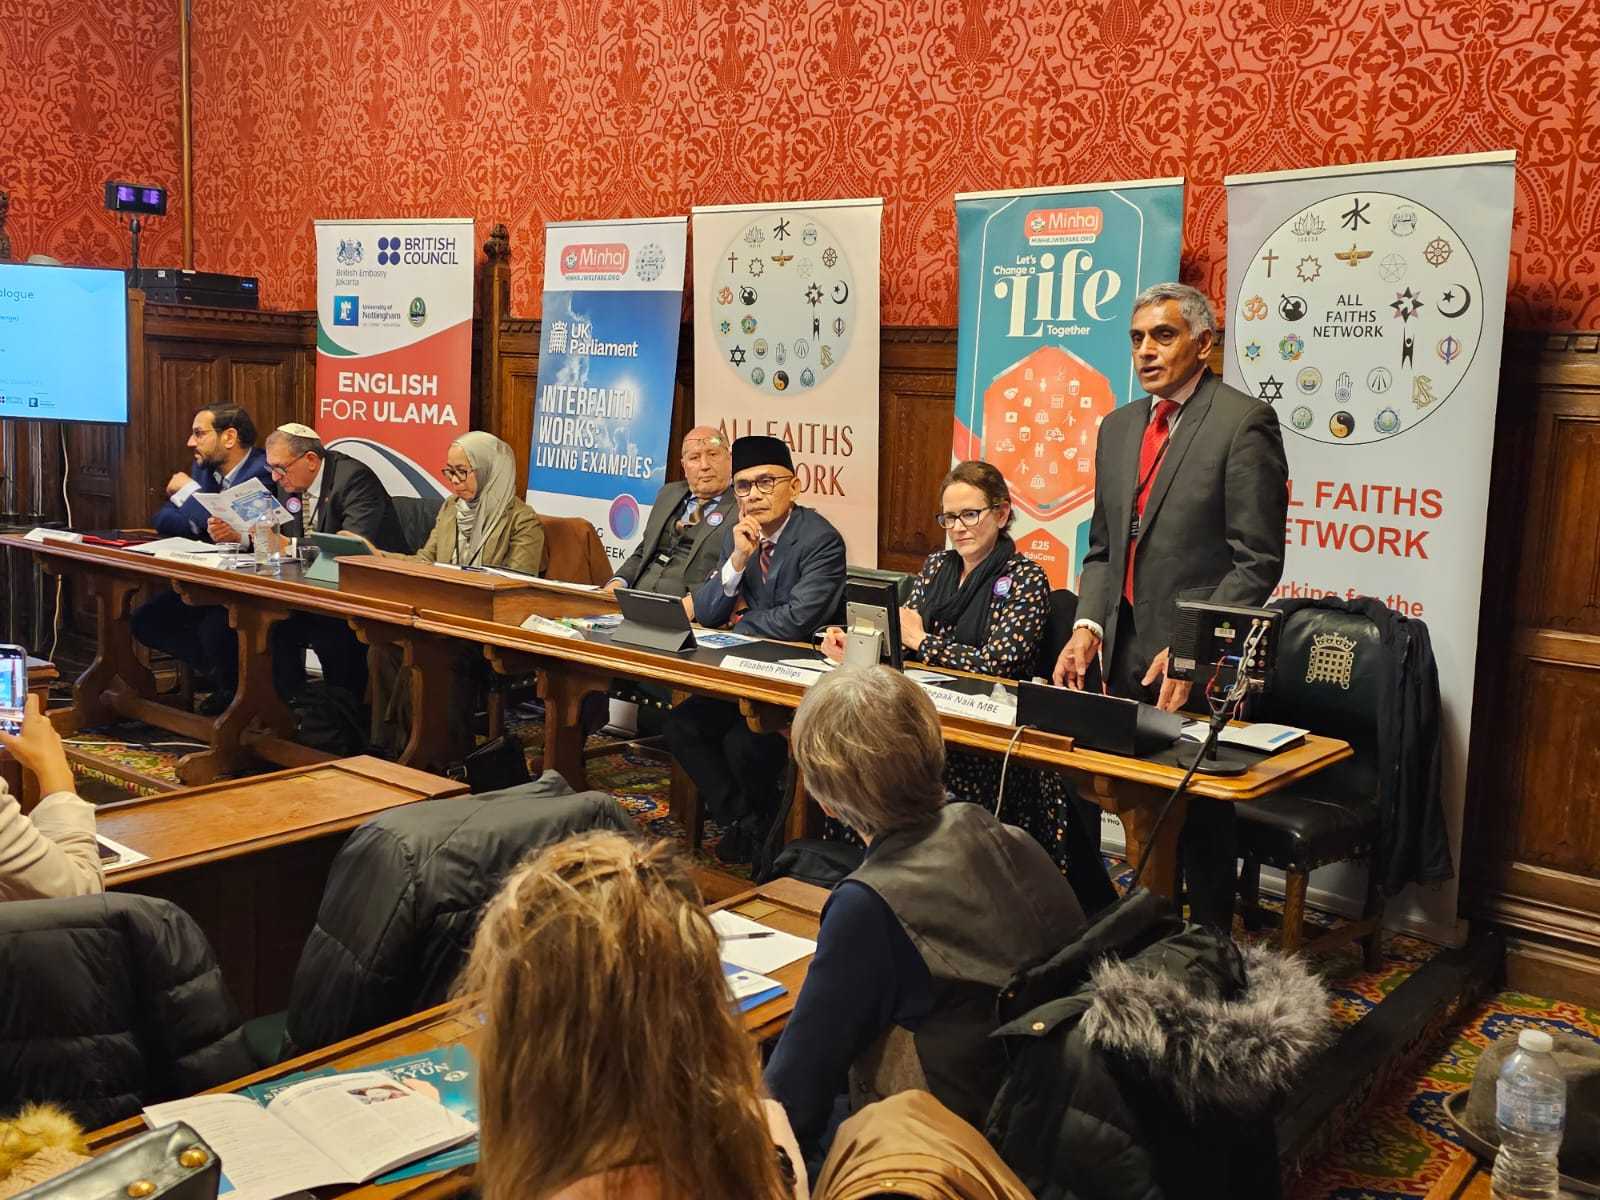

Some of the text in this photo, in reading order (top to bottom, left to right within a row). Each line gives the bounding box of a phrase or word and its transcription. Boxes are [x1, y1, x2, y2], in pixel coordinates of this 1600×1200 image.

[1048, 211, 1100, 231] Minhaj
[404, 237, 457, 250] BRITISH
[403, 251, 459, 265] COUNCIL
[579, 247, 627, 271] Minhaj
[1016, 255, 1037, 265] Let's
[993, 265, 1028, 277] Change
[994, 249, 1122, 337] Life
[1336, 294, 1364, 307] ALL
[362, 311, 401, 322] Nottingham
[1326, 310, 1377, 323] FAITHS
[570, 323, 590, 338] UK
[1047, 324, 1091, 338] Together
[1312, 325, 1384, 338] NETWORK
[569, 337, 639, 358] Parliament
[338, 371, 438, 397] ENGLISH
[541, 384, 635, 420] INTERFAITH
[320, 398, 459, 427] FOR ULAMA
[538, 415, 600, 450] WORKS:
[536, 447, 653, 480] LIVING EXAMPLES
[1315, 481, 1444, 520] FAITHS
[954, 695, 975, 708] Naik
[976, 702, 1000, 715] MBE
